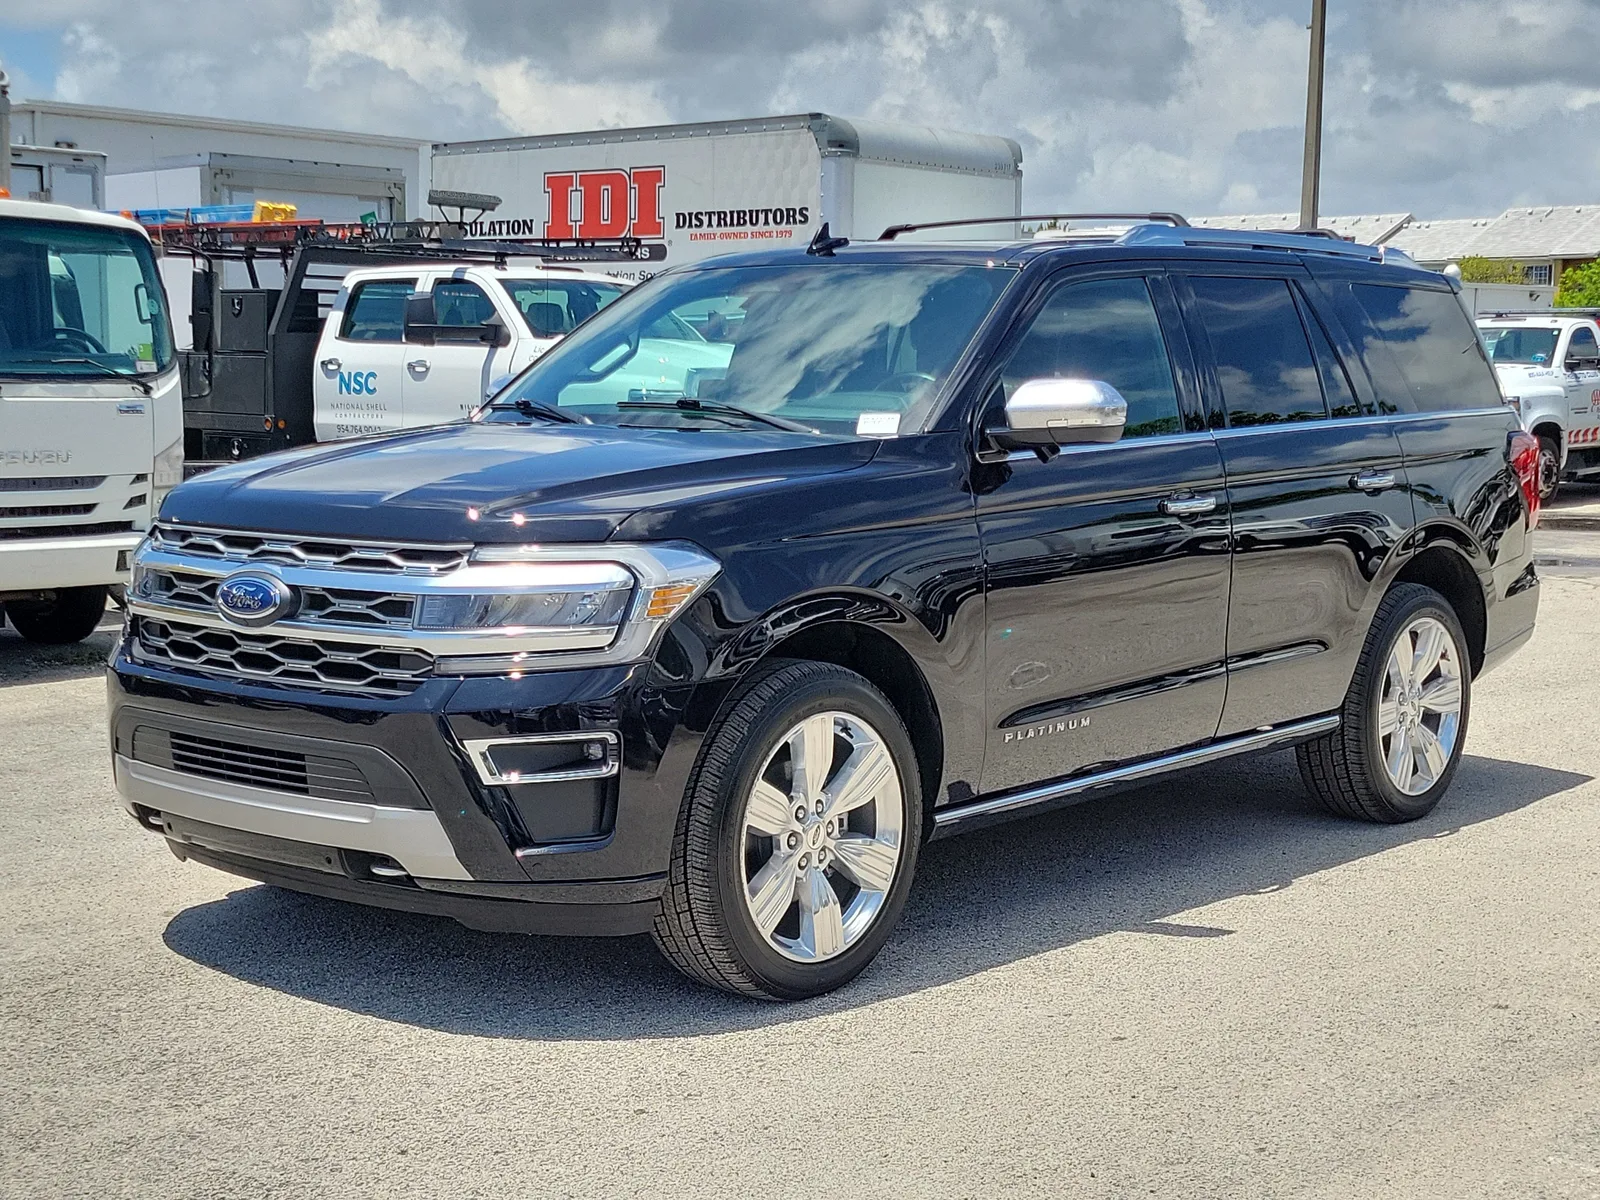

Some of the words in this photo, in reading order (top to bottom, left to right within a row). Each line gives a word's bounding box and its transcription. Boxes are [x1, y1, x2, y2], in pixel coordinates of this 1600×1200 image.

[543, 165, 666, 240] IDI
[674, 207, 809, 230] DISTRIBUTORS
[690, 231, 748, 241] FAMILY-OWNED
[750, 231, 774, 239] SINCE
[775, 230, 793, 238] 1979
[338, 371, 378, 396] NSC
[330, 402, 364, 411] NATIONAL
[366, 403, 387, 411] SHELL
[227, 584, 264, 609] Ford
[1003, 716, 1091, 743] PLATINUM
